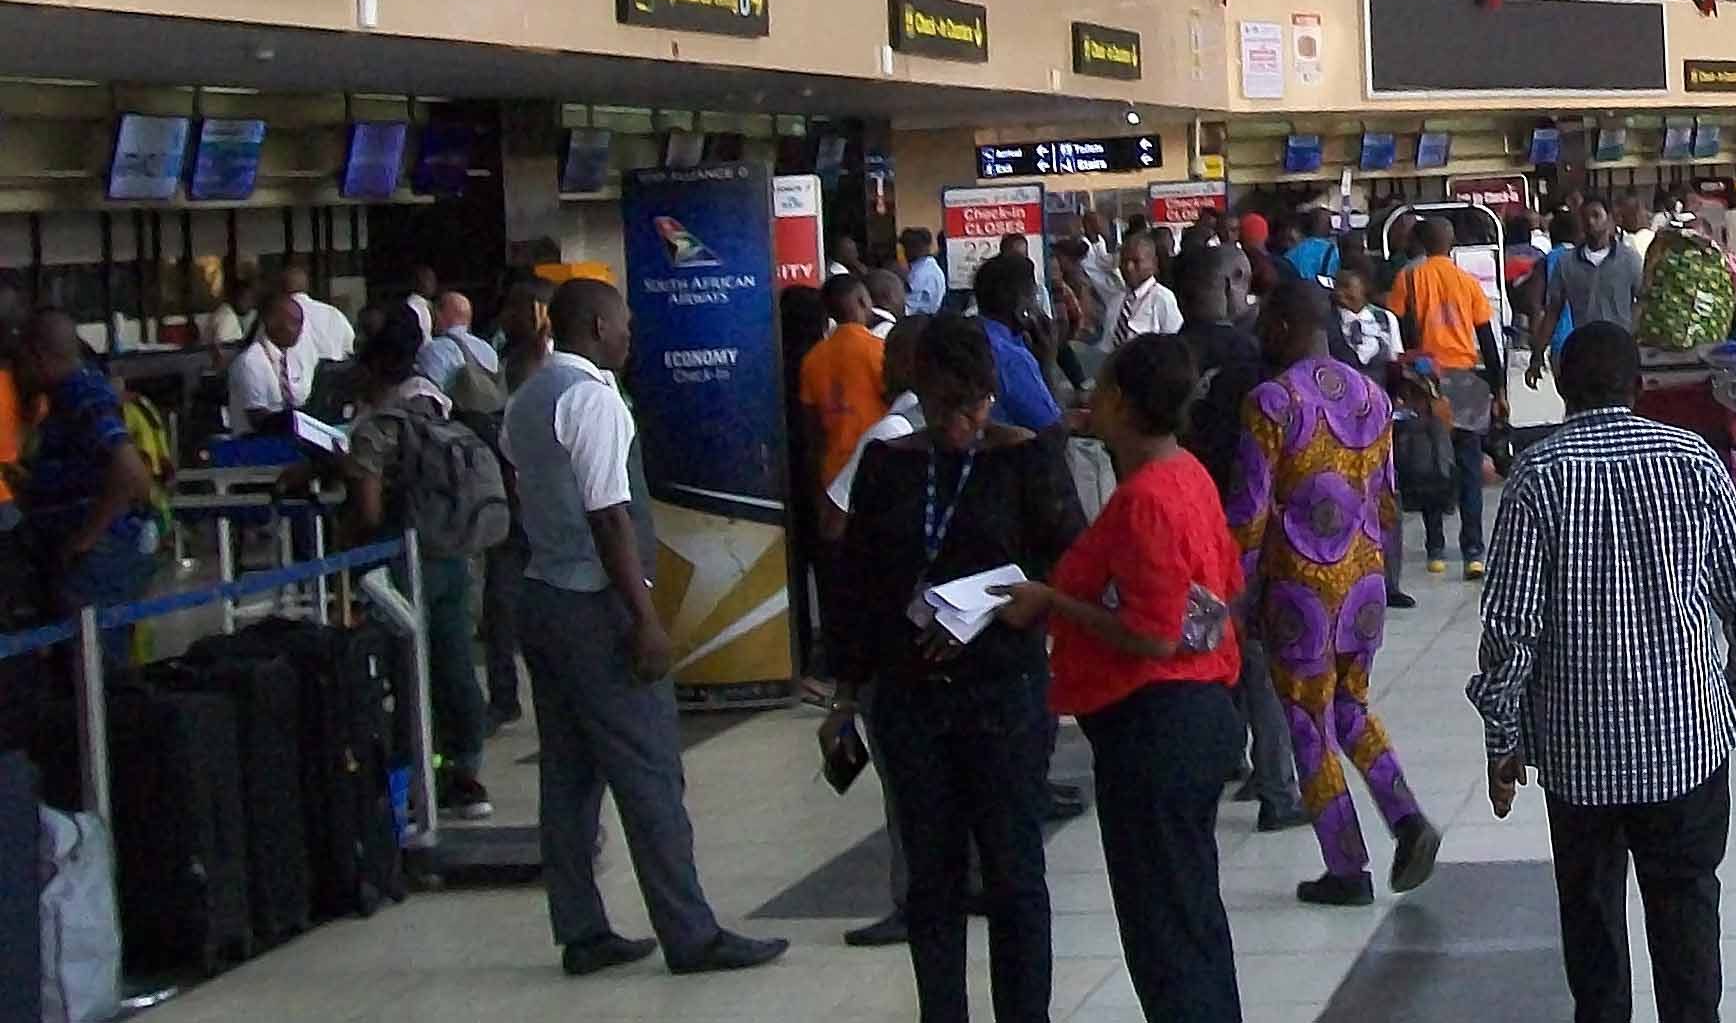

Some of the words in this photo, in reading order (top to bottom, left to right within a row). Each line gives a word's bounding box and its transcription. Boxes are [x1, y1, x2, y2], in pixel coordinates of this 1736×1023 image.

[1077, 159, 1107, 171] Stairs
[964, 221, 1025, 236] CLOSES
[643, 279, 688, 292] SOUTH
[693, 275, 756, 291] AFRICAN
[670, 291, 729, 305] AIRWAYS
[664, 347, 738, 369] ECONOMY
